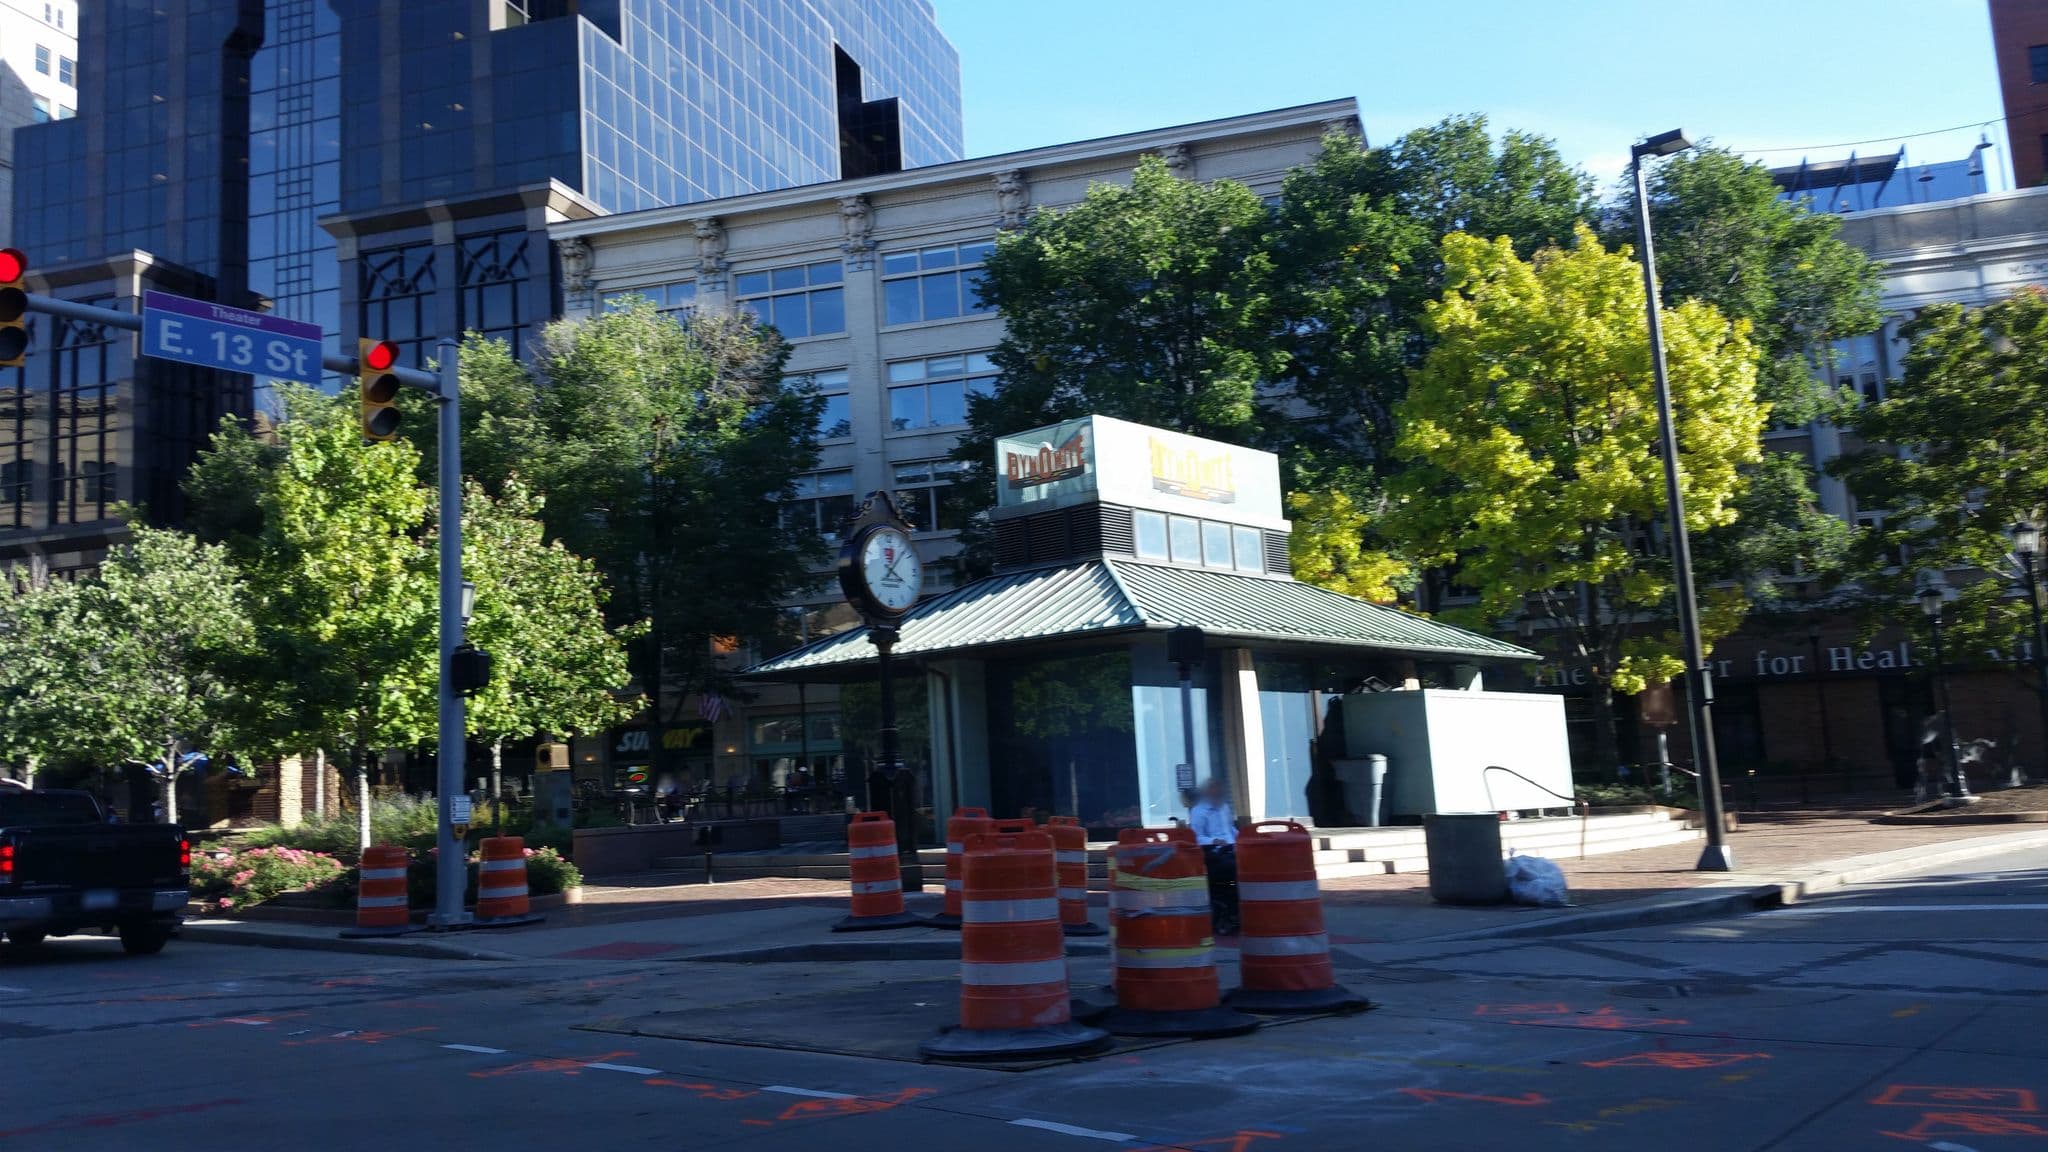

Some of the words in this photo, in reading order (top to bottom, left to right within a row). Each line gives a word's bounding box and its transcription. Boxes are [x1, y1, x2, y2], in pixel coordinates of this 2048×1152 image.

[211, 306, 261, 326] Theater
[160, 318, 193, 355] E.
[211, 331, 253, 366] 13
[266, 340, 308, 375] St
[1754, 650, 1805, 675] for
[1828, 641, 1928, 671] Heal
